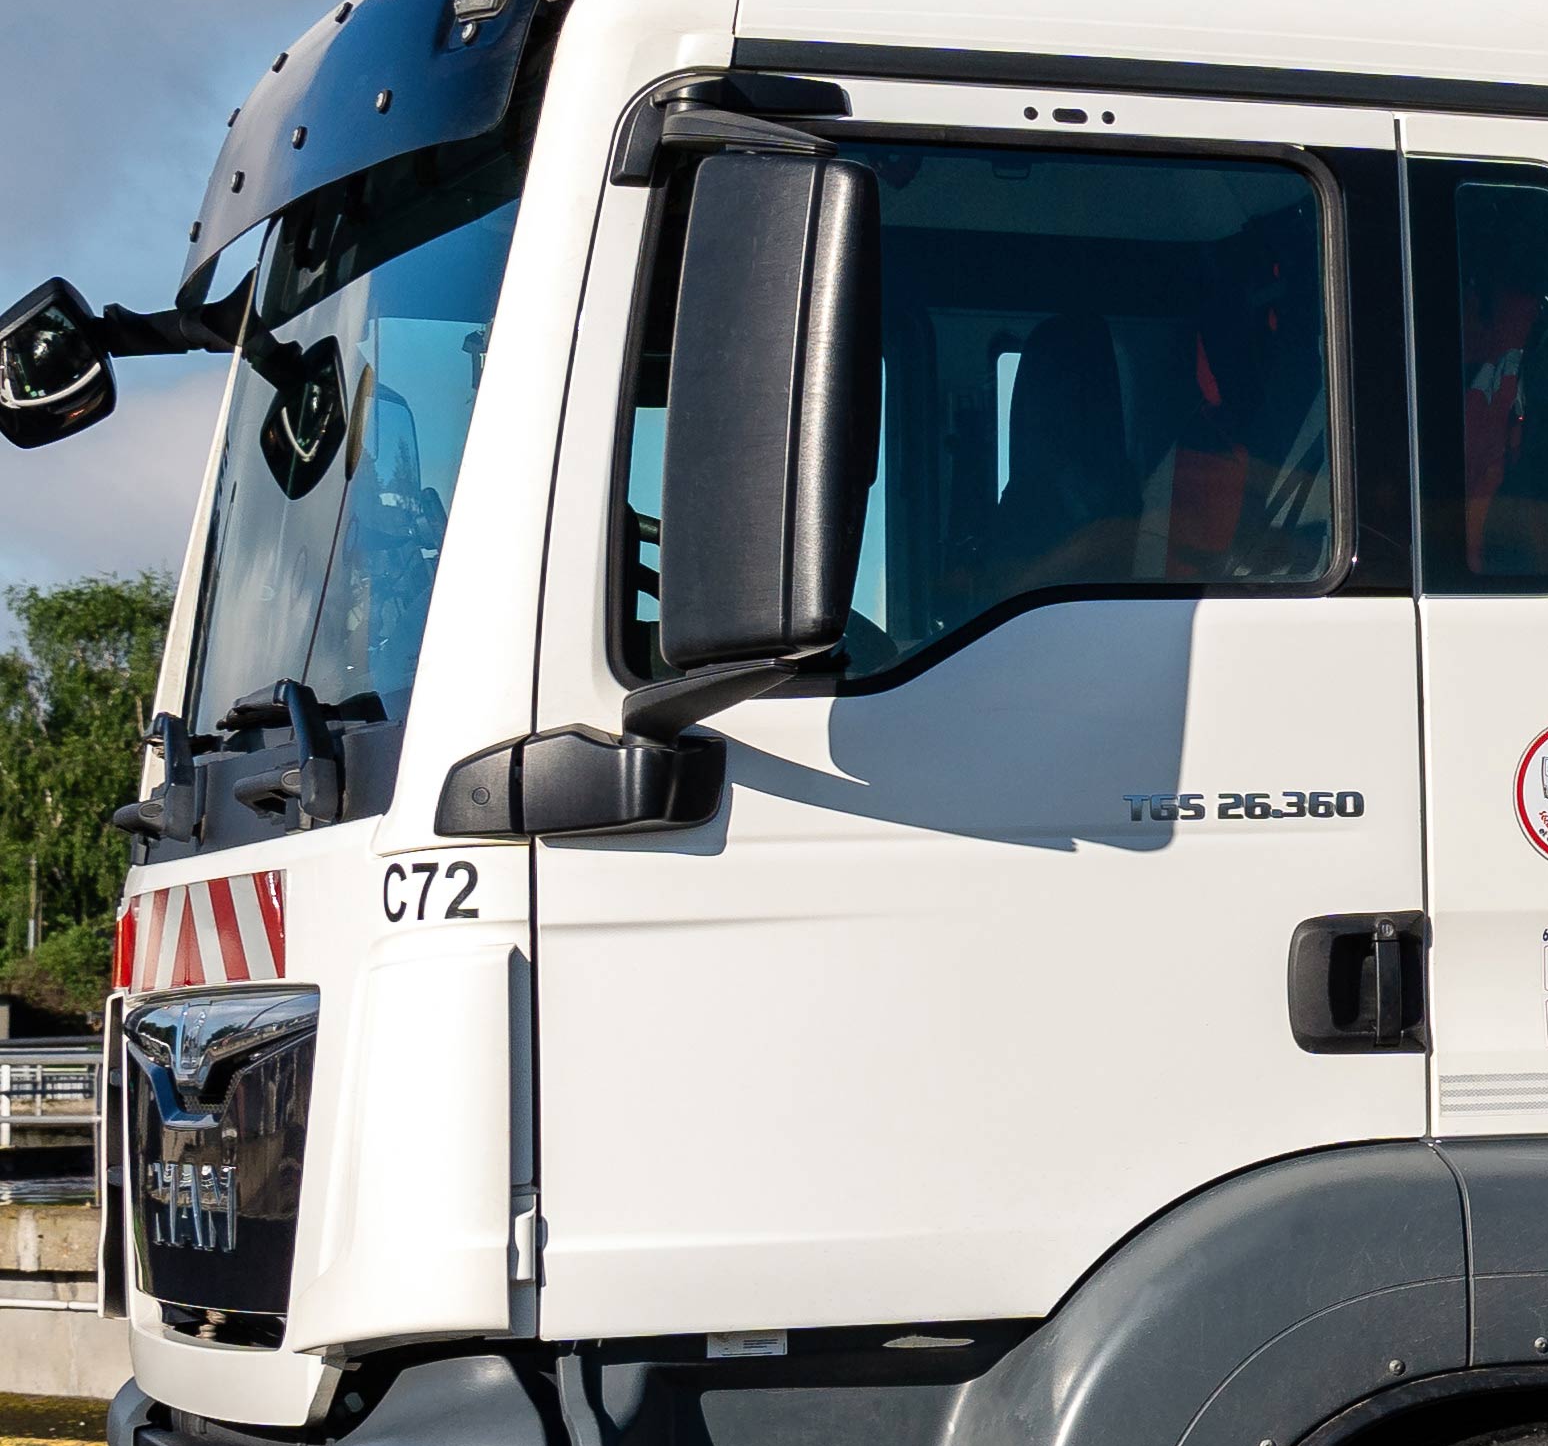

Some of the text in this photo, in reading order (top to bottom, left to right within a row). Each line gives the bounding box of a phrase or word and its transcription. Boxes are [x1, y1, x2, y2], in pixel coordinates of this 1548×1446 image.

[1123, 791, 1365, 822] TGS 26.360
[384, 862, 478, 922] C72
